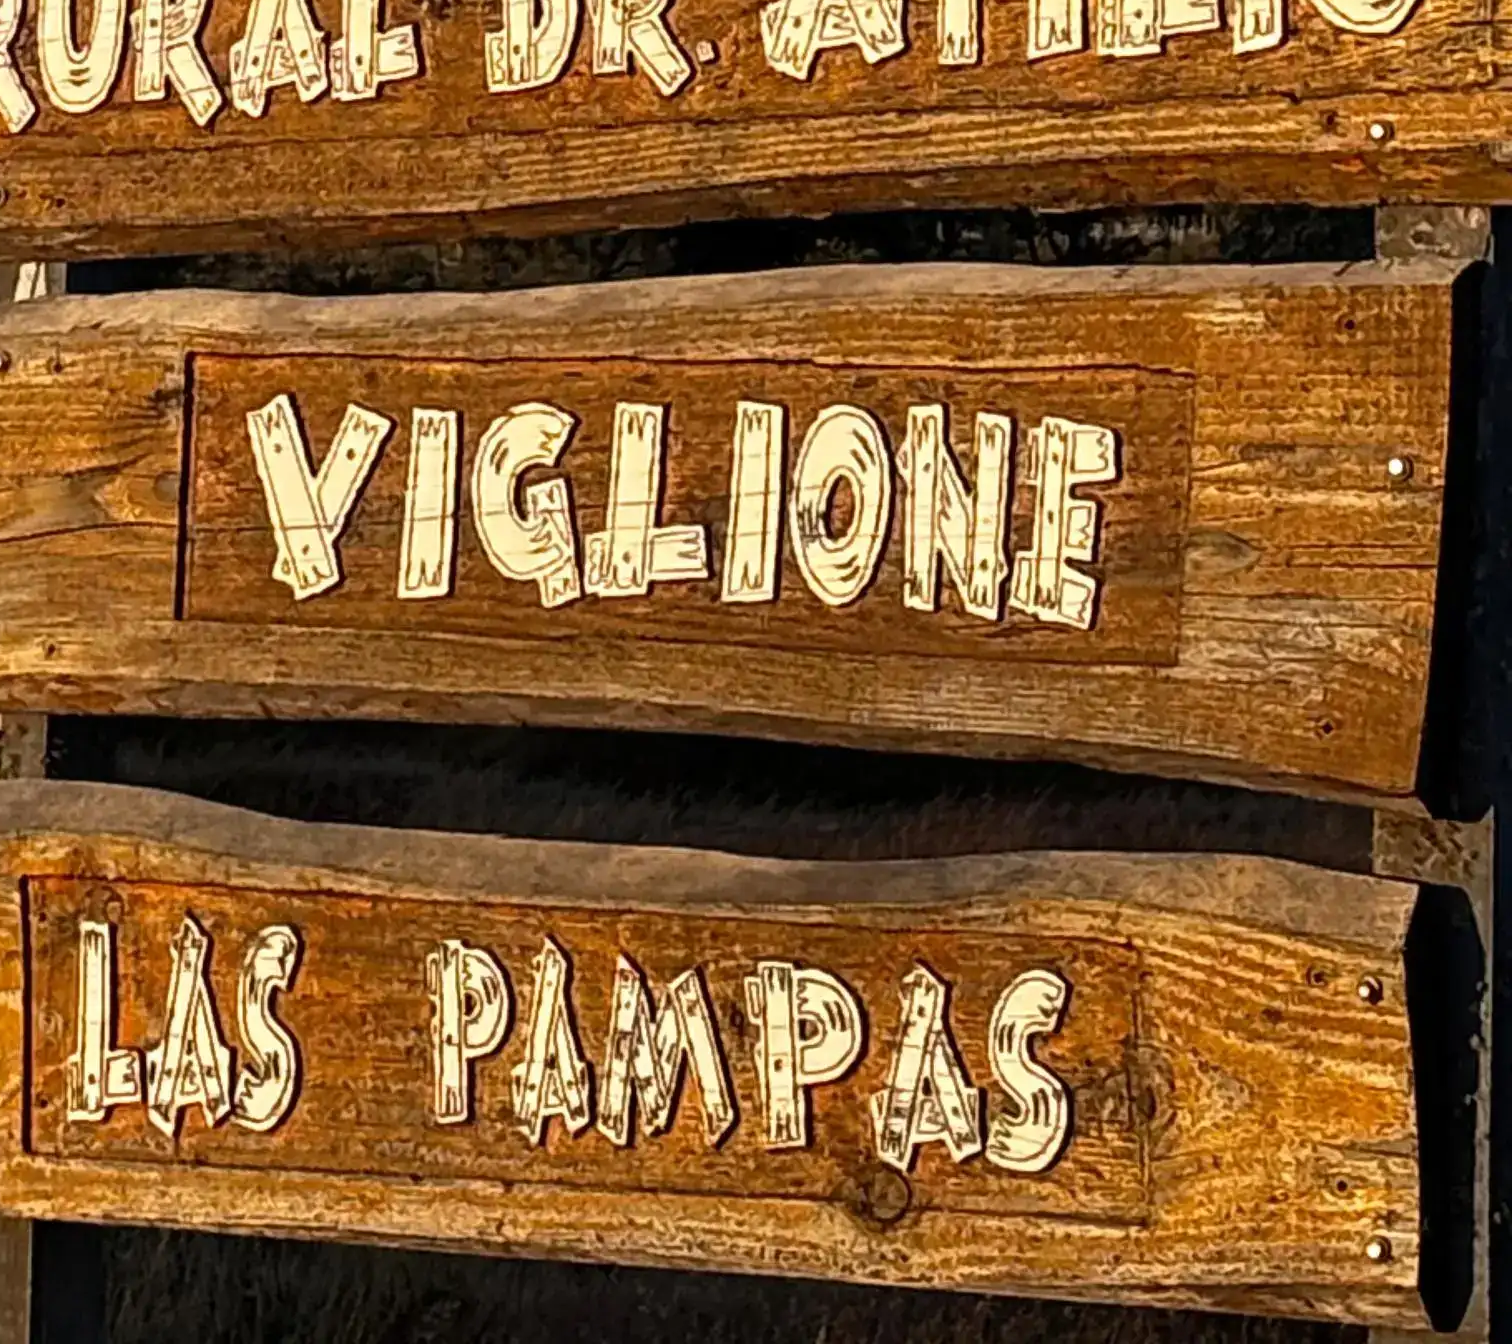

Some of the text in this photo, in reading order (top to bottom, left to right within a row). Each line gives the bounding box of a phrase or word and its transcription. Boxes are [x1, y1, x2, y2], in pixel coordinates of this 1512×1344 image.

[247, 395, 1115, 629] VIGLIONE
[67, 918, 1070, 1171] LAS PAMPAS
